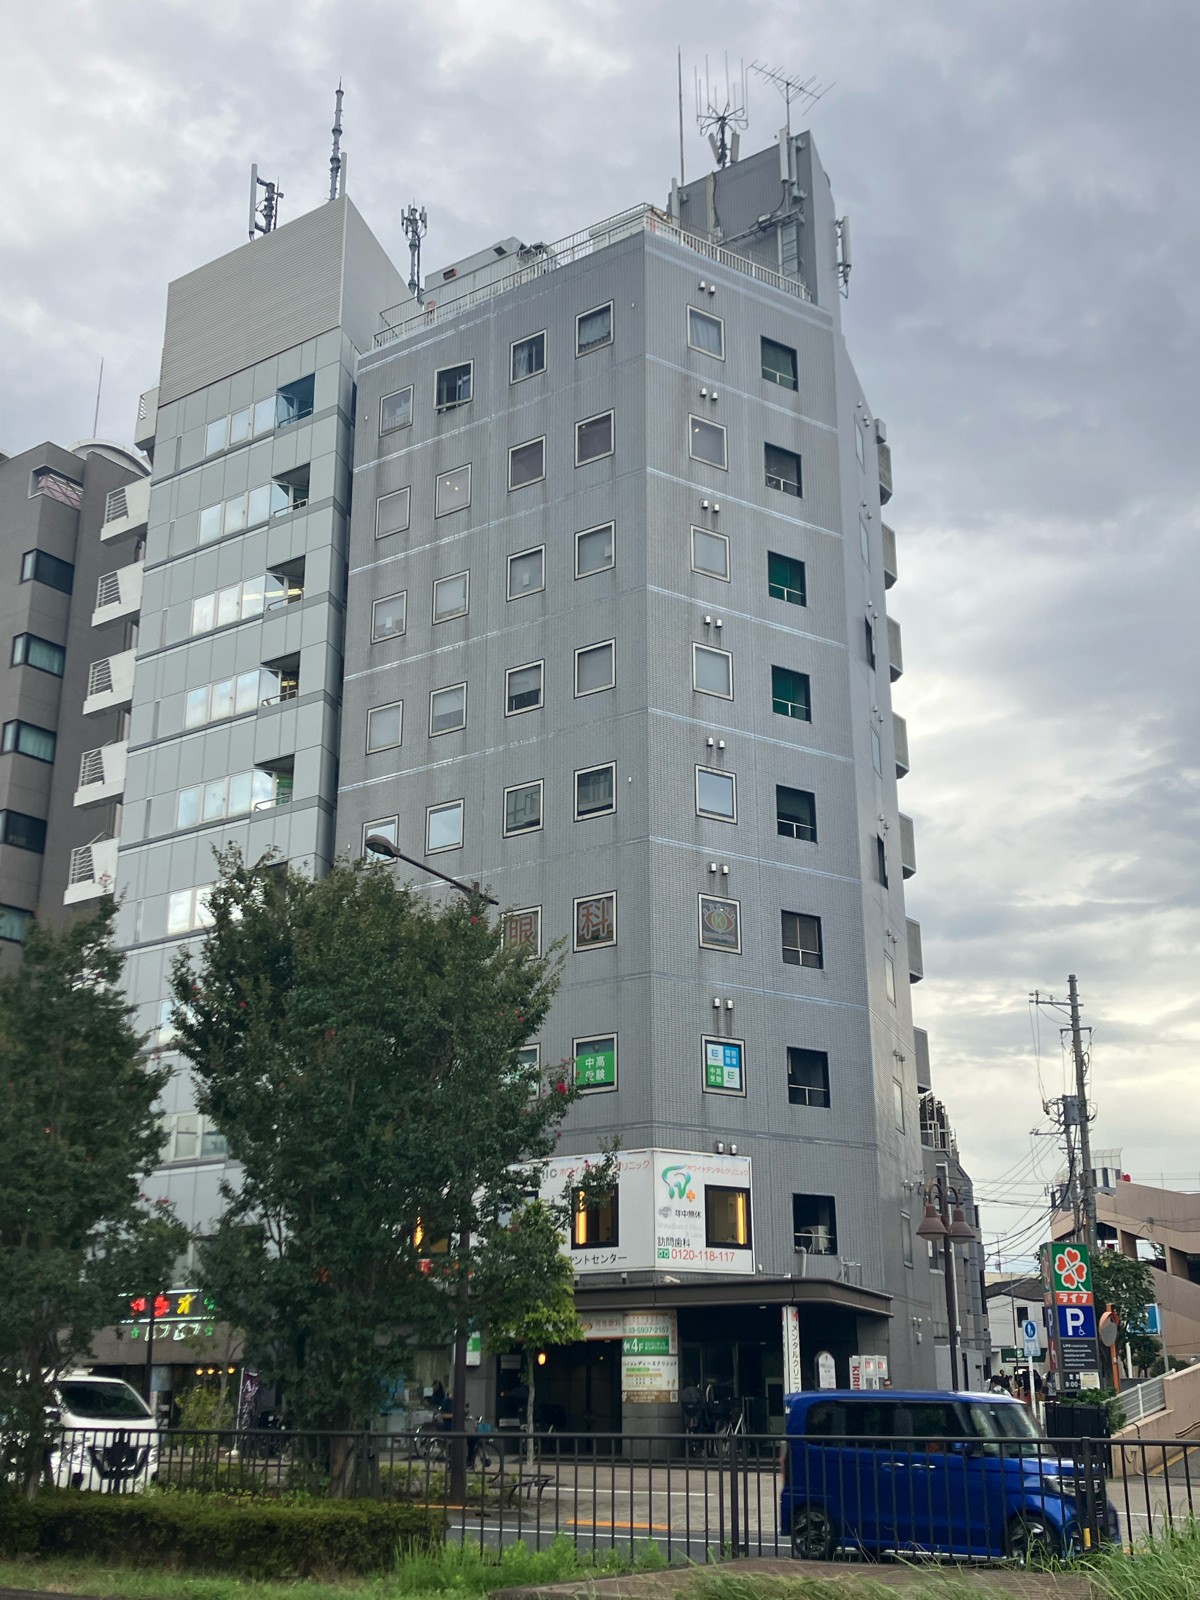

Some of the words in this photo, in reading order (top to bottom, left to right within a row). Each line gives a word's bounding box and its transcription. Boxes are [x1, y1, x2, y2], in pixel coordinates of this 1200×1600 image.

[580, 899, 608, 939] 科
[687, 1165, 749, 1177] ホワイトデンタルクリニック
[657, 1236, 690, 1248] 訪問歯科
[570, 1253, 627, 1266] ントセンター
[671, 1248, 735, 1262] 0120-118-117
[1059, 1293, 1088, 1304] ライフ
[1066, 1308, 1084, 1336] P
